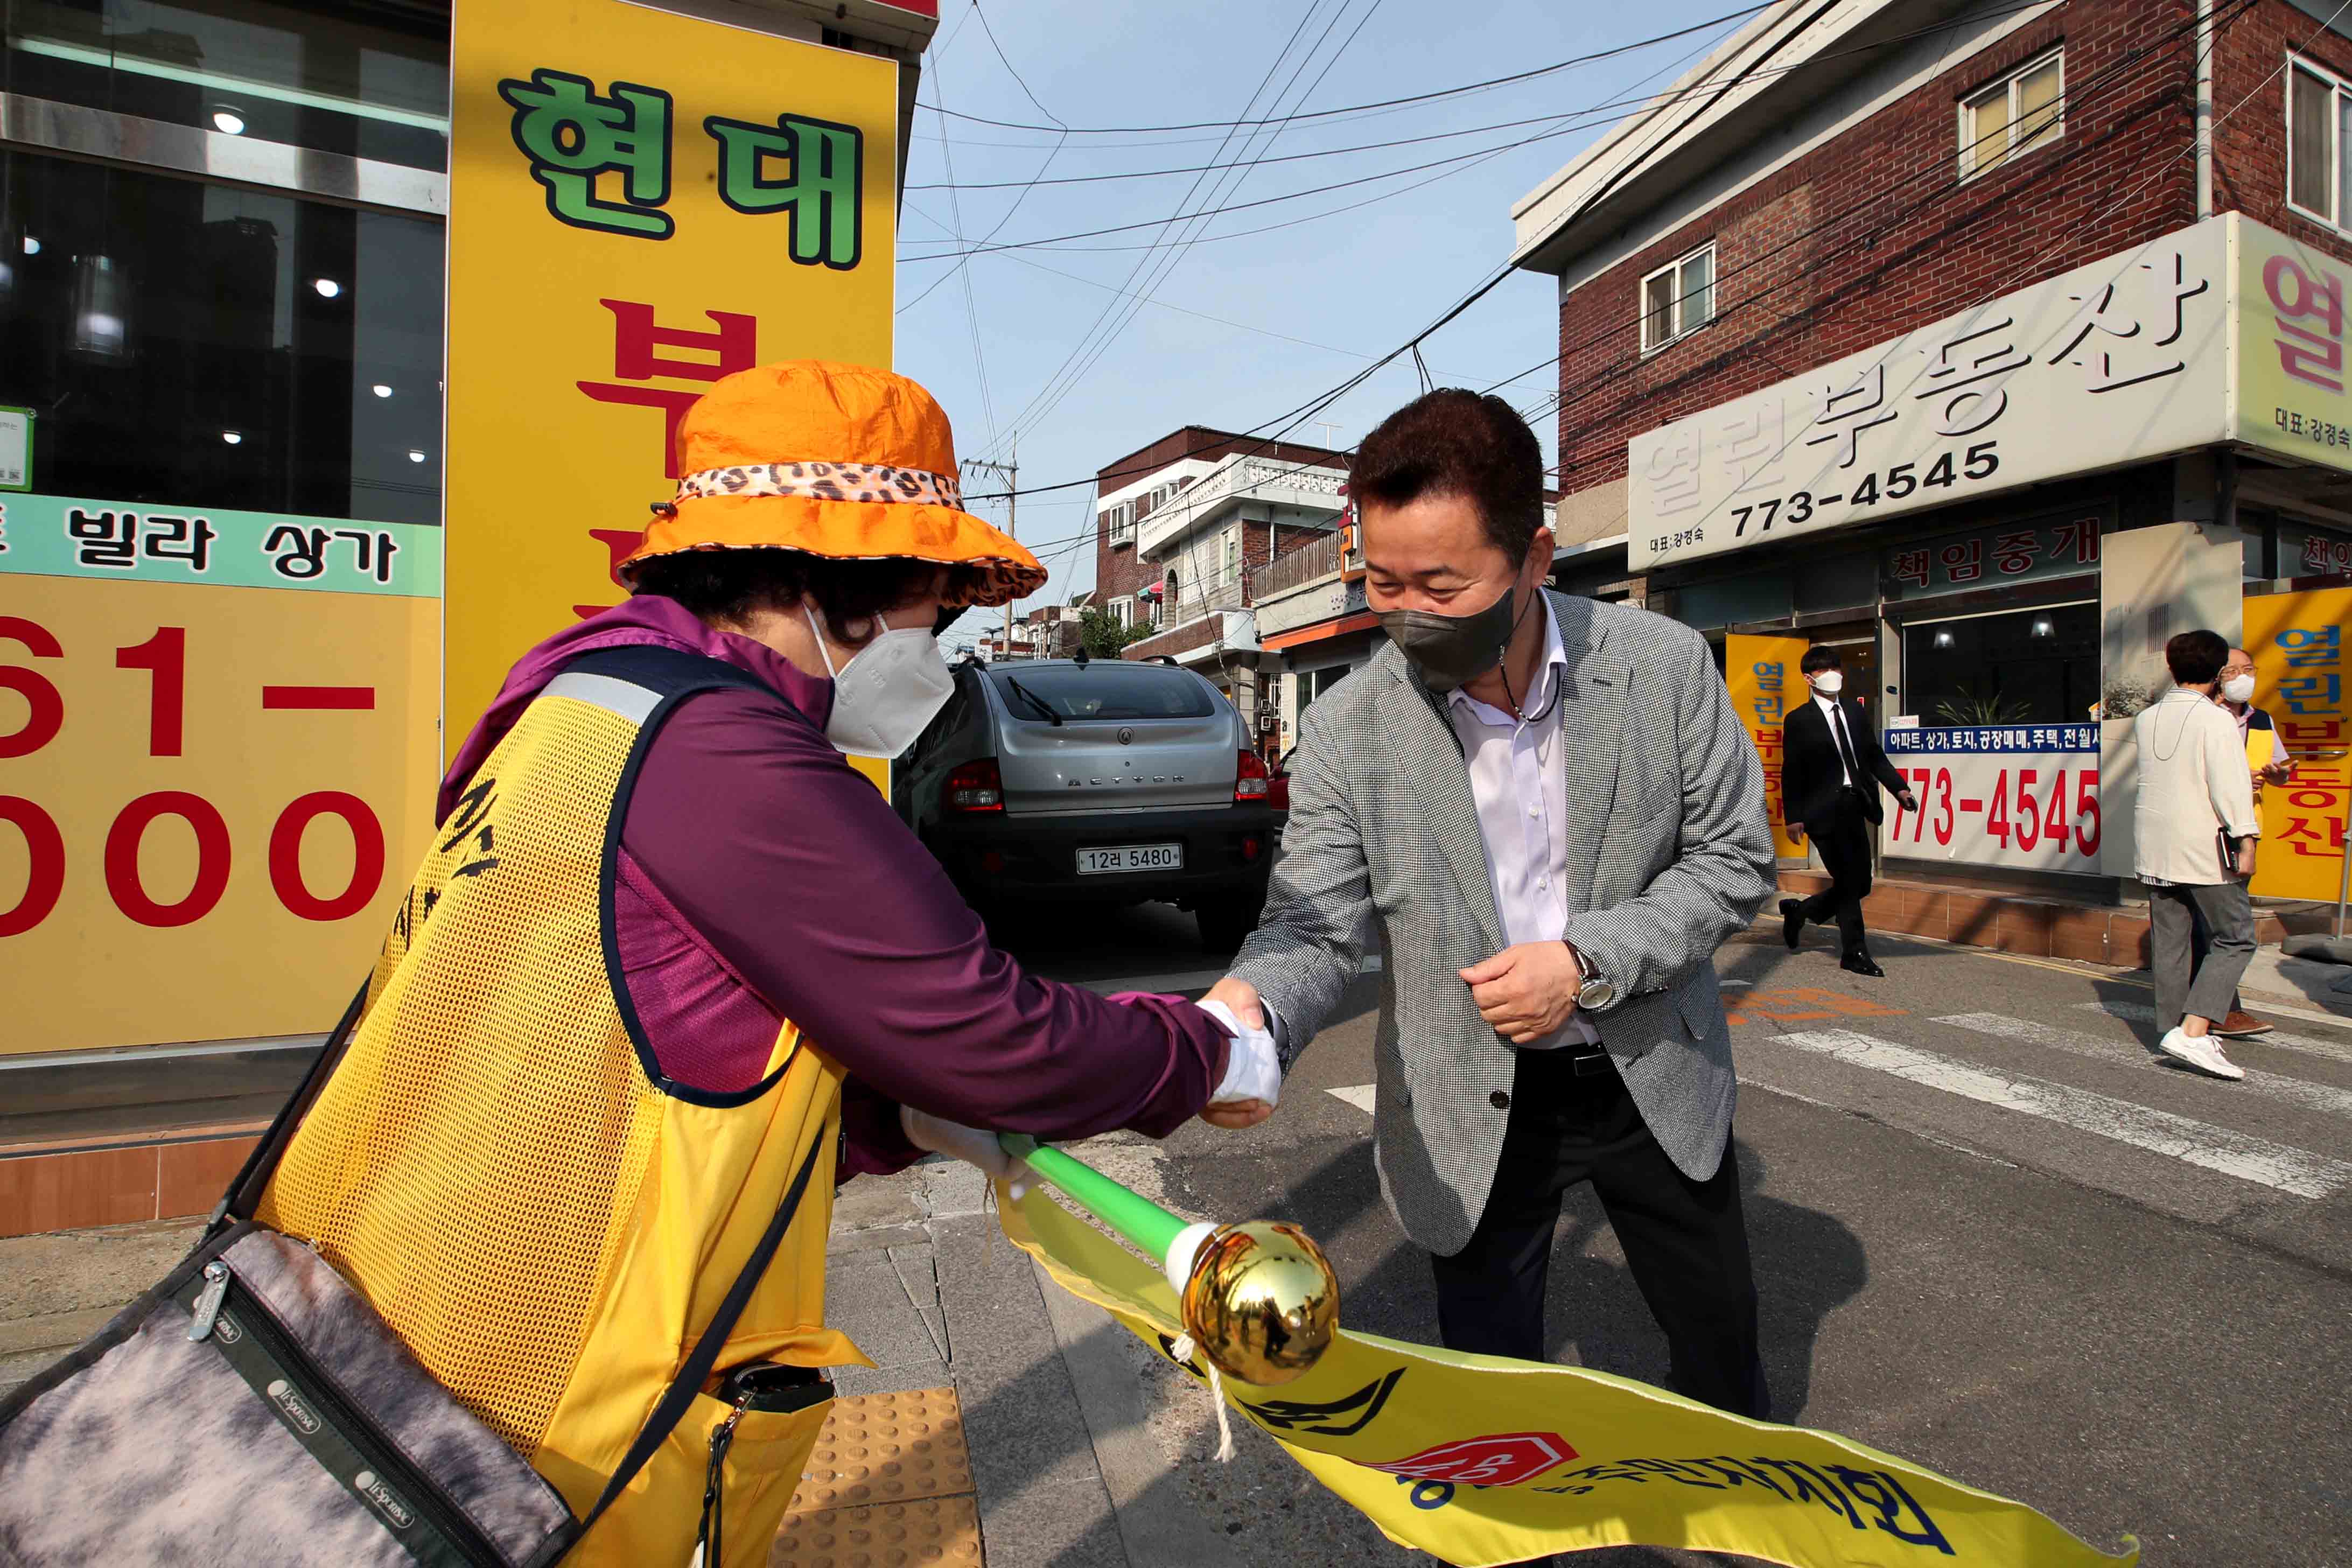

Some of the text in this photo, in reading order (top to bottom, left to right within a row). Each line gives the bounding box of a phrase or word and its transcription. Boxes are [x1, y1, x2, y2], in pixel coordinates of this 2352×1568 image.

[497, 67, 864, 271] 현대
[2263, 255, 2344, 394] 열
[1731, 441, 1999, 537] 773-4545
[64, 505, 219, 575] 빌라
[260, 522, 400, 586] 상가
[1892, 517, 2100, 587] 책임중개
[1068, 775, 1184, 787] ACTYON
[1130, 848, 1172, 866] 5480
